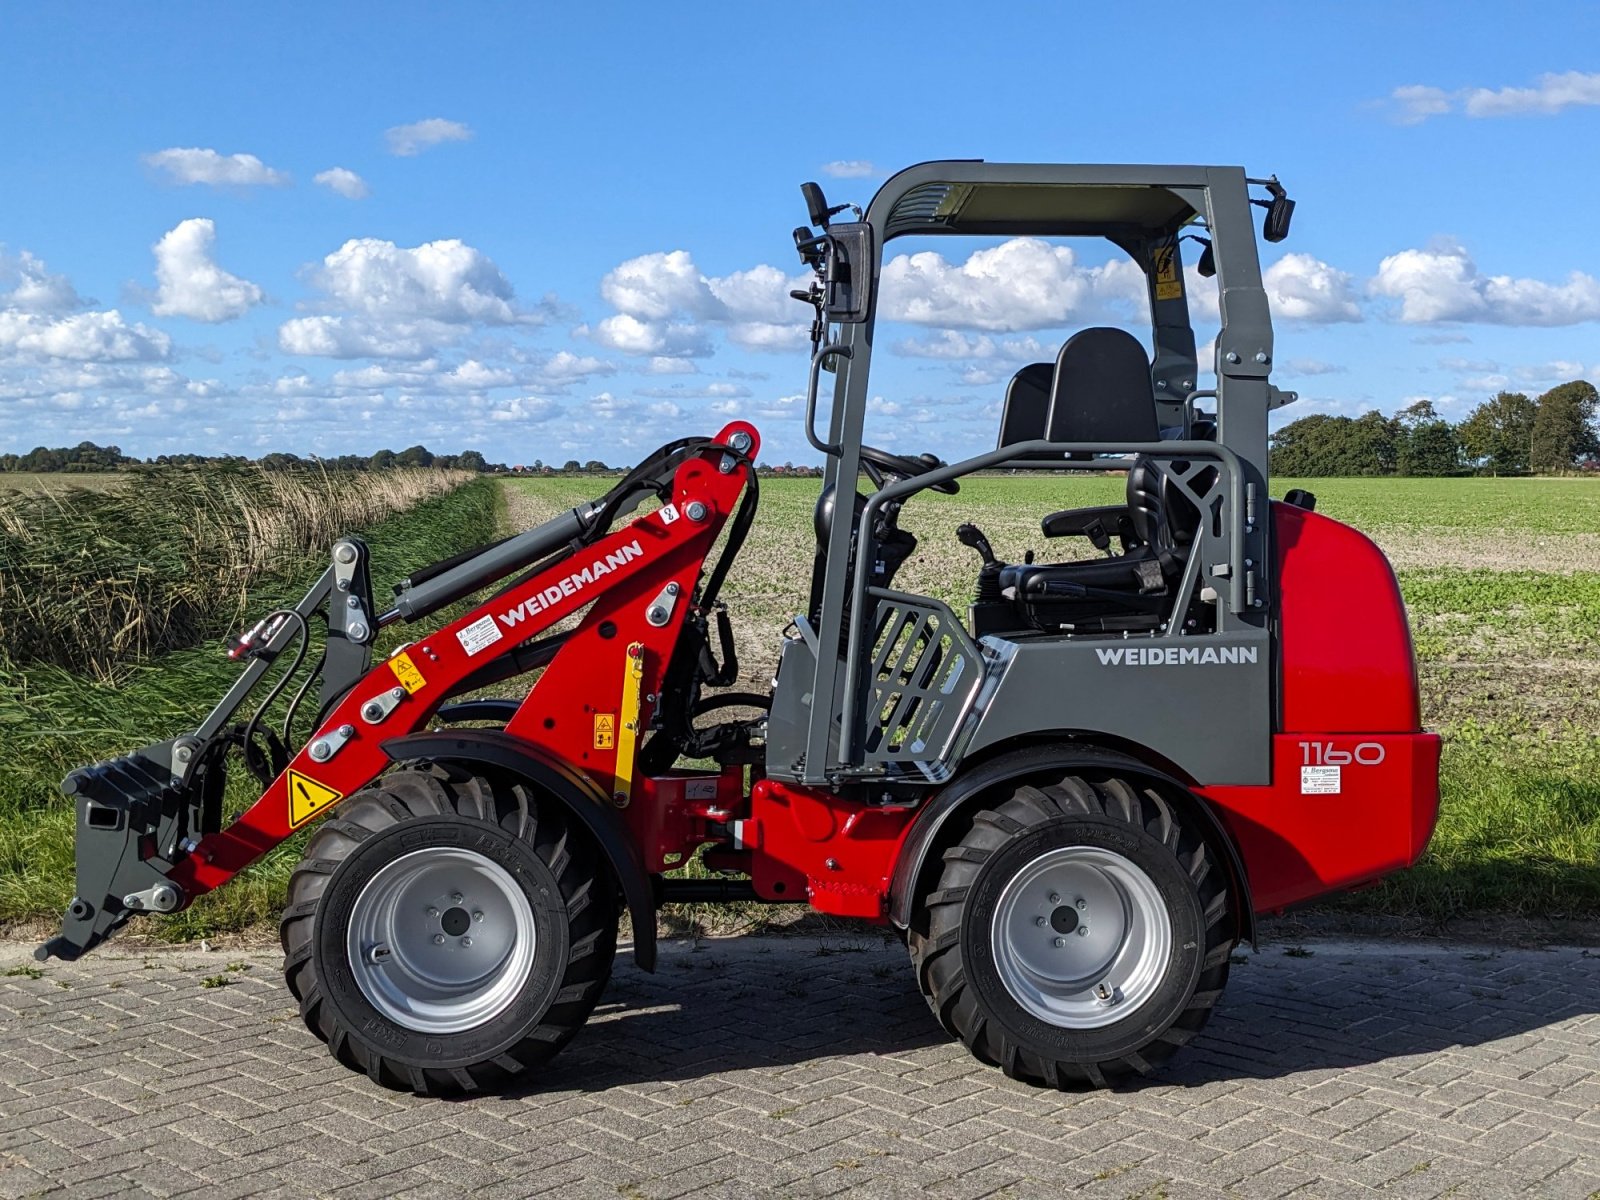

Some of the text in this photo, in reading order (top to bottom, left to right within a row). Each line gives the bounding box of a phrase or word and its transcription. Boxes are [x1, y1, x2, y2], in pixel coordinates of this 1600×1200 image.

[498, 540, 643, 628] WEIDEMANN
[1095, 646, 1258, 666] WEIDEMANN
[1299, 742, 1385, 764] 1160
